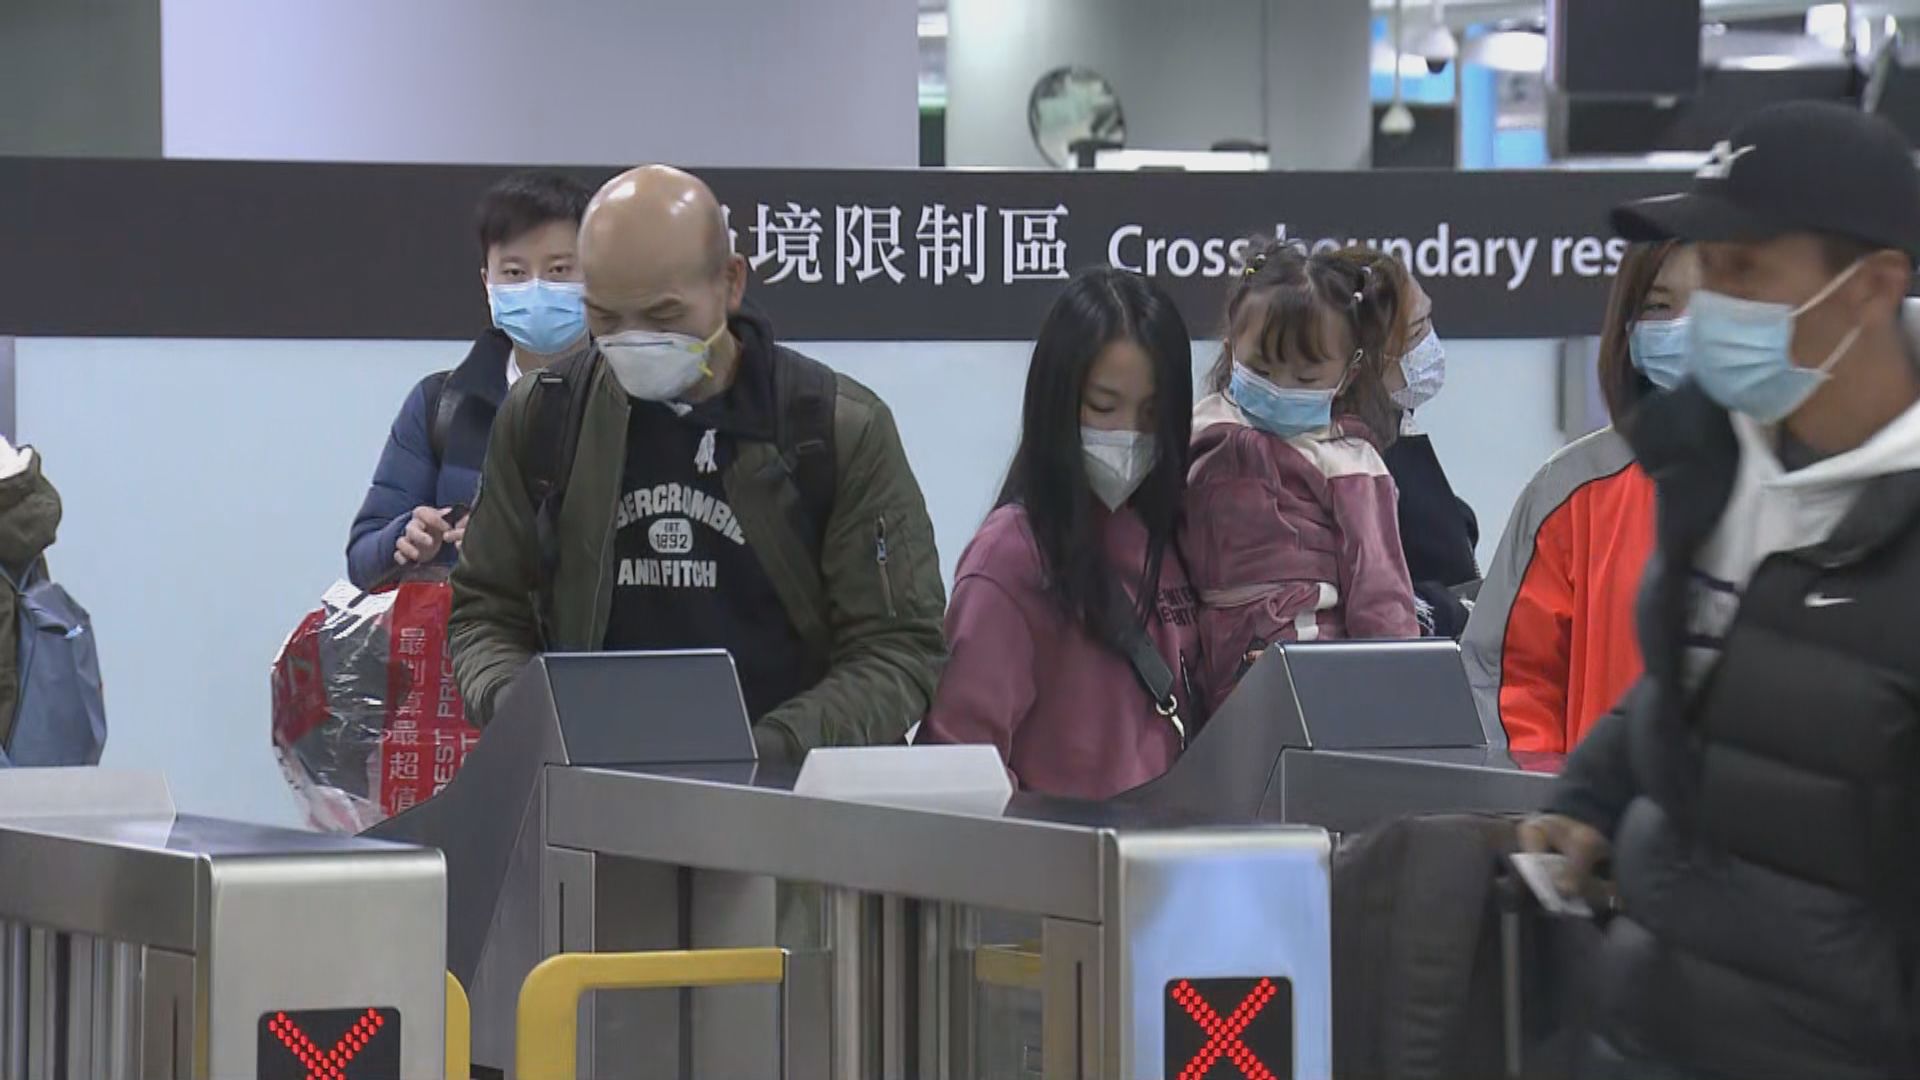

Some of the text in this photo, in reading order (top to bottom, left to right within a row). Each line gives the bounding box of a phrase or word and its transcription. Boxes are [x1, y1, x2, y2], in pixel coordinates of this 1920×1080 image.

[721, 203, 1070, 285] 境限制區
[655, 533, 689, 550] 1892
